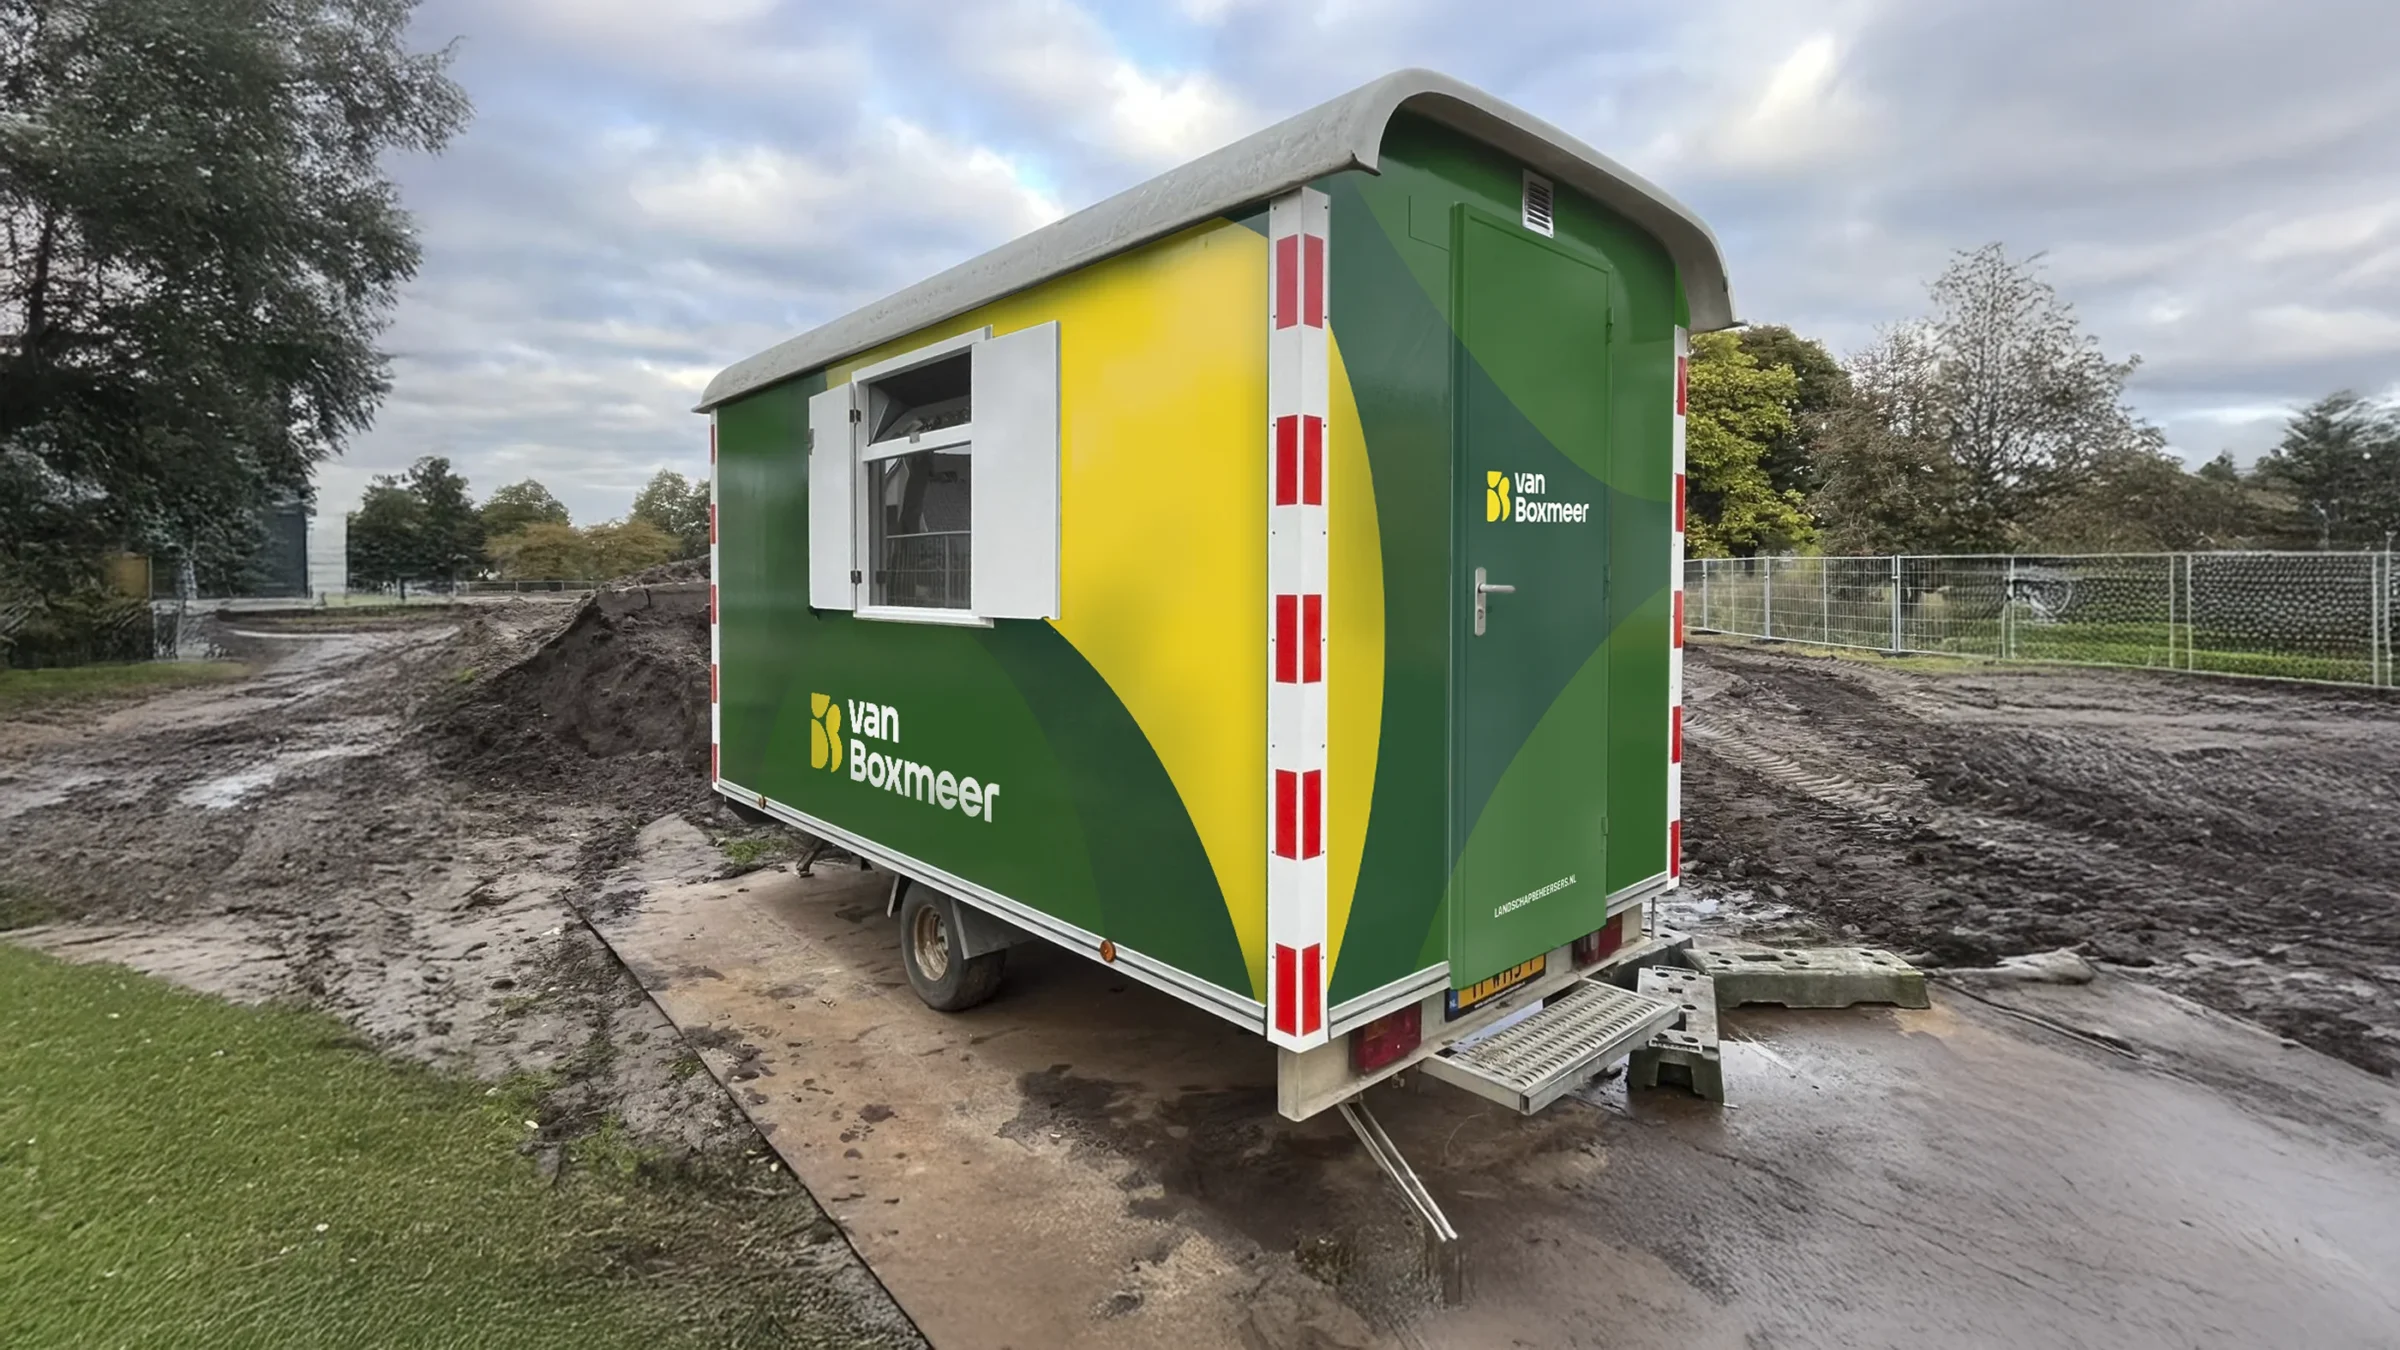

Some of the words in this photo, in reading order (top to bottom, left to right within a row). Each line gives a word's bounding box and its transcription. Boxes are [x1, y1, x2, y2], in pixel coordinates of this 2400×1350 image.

[1514, 472, 1546, 495] van
[1514, 496, 1590, 523] Boxmeer
[847, 698, 900, 744] van
[849, 738, 1001, 824] Boxmeer
[1493, 873, 1577, 919] LANDSCHAPBEHEERSERS.NL
